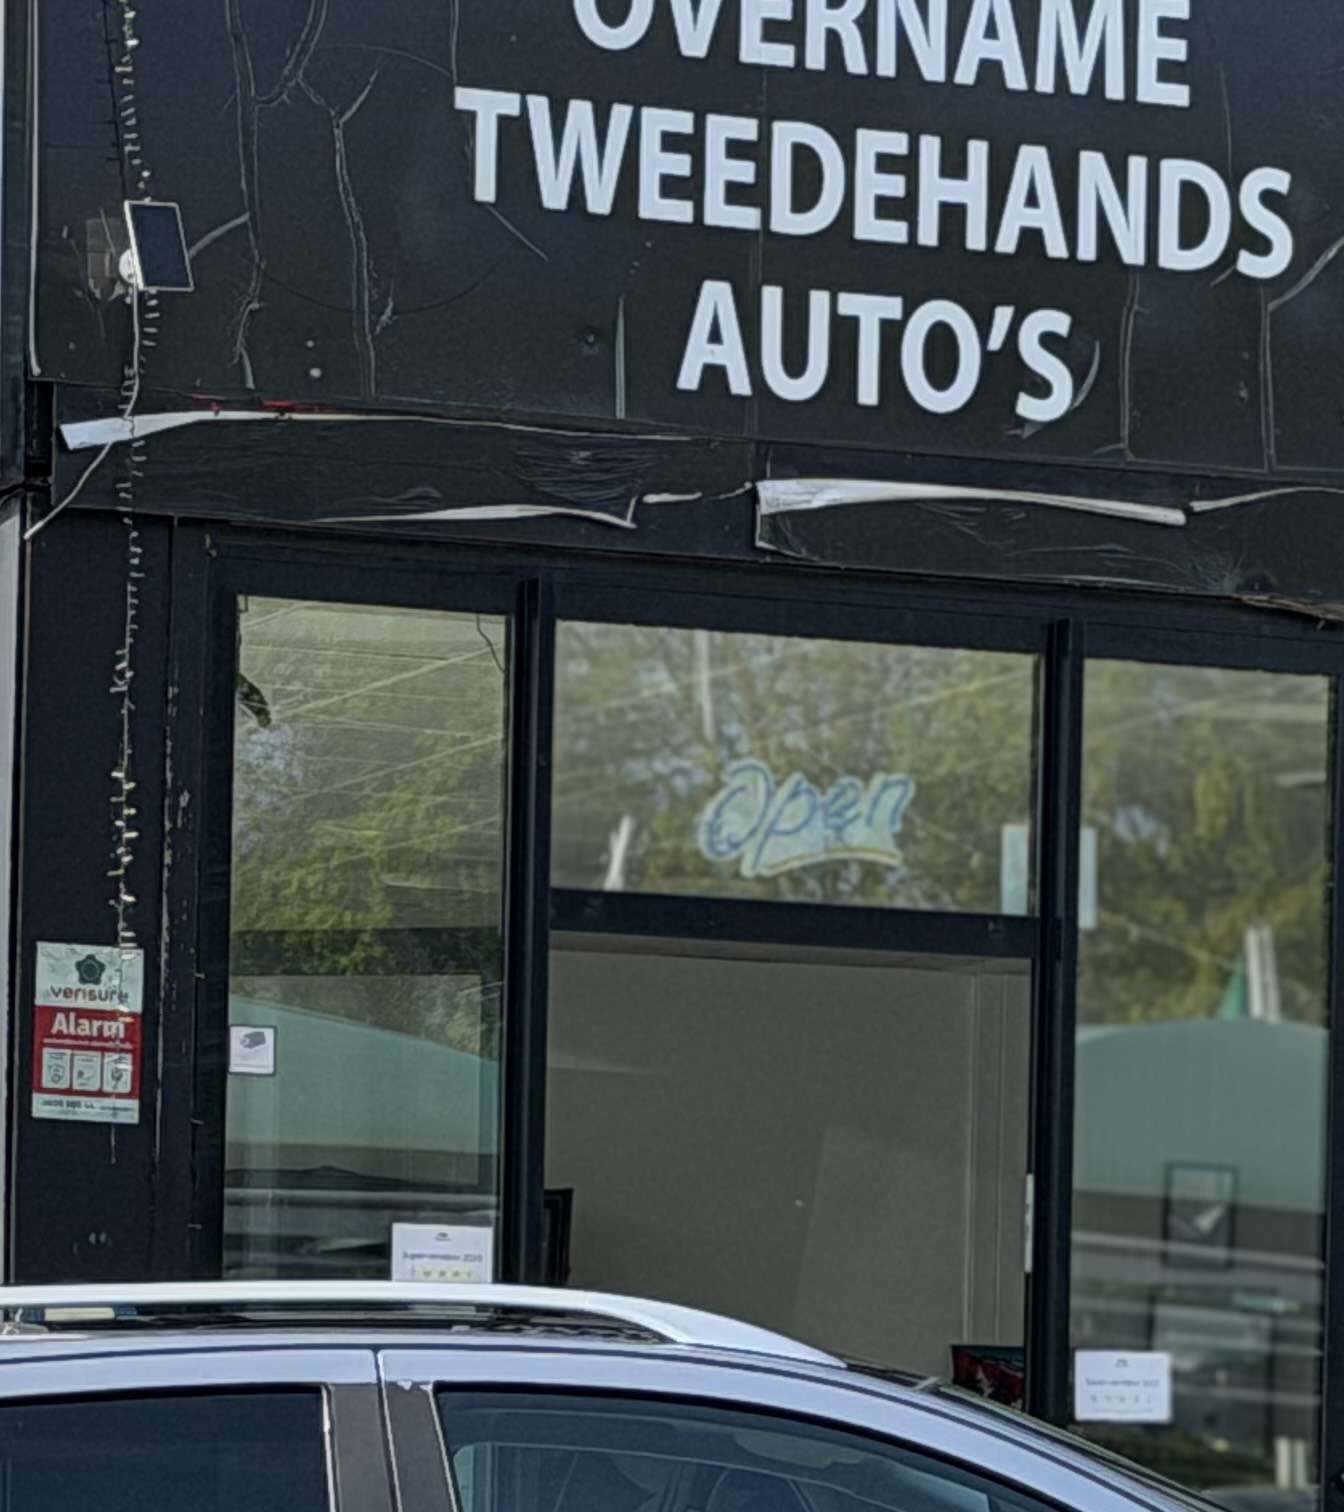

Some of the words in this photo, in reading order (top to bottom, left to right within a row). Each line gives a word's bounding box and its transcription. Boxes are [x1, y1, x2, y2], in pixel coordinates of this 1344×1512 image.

[455, 87, 1293, 279] TWEEDEHANDS
[676, 280, 1075, 423] AUTO'S
[702, 759, 915, 876] Open
[49, 984, 129, 1005] verisure
[50, 1011, 126, 1040] Alarm
